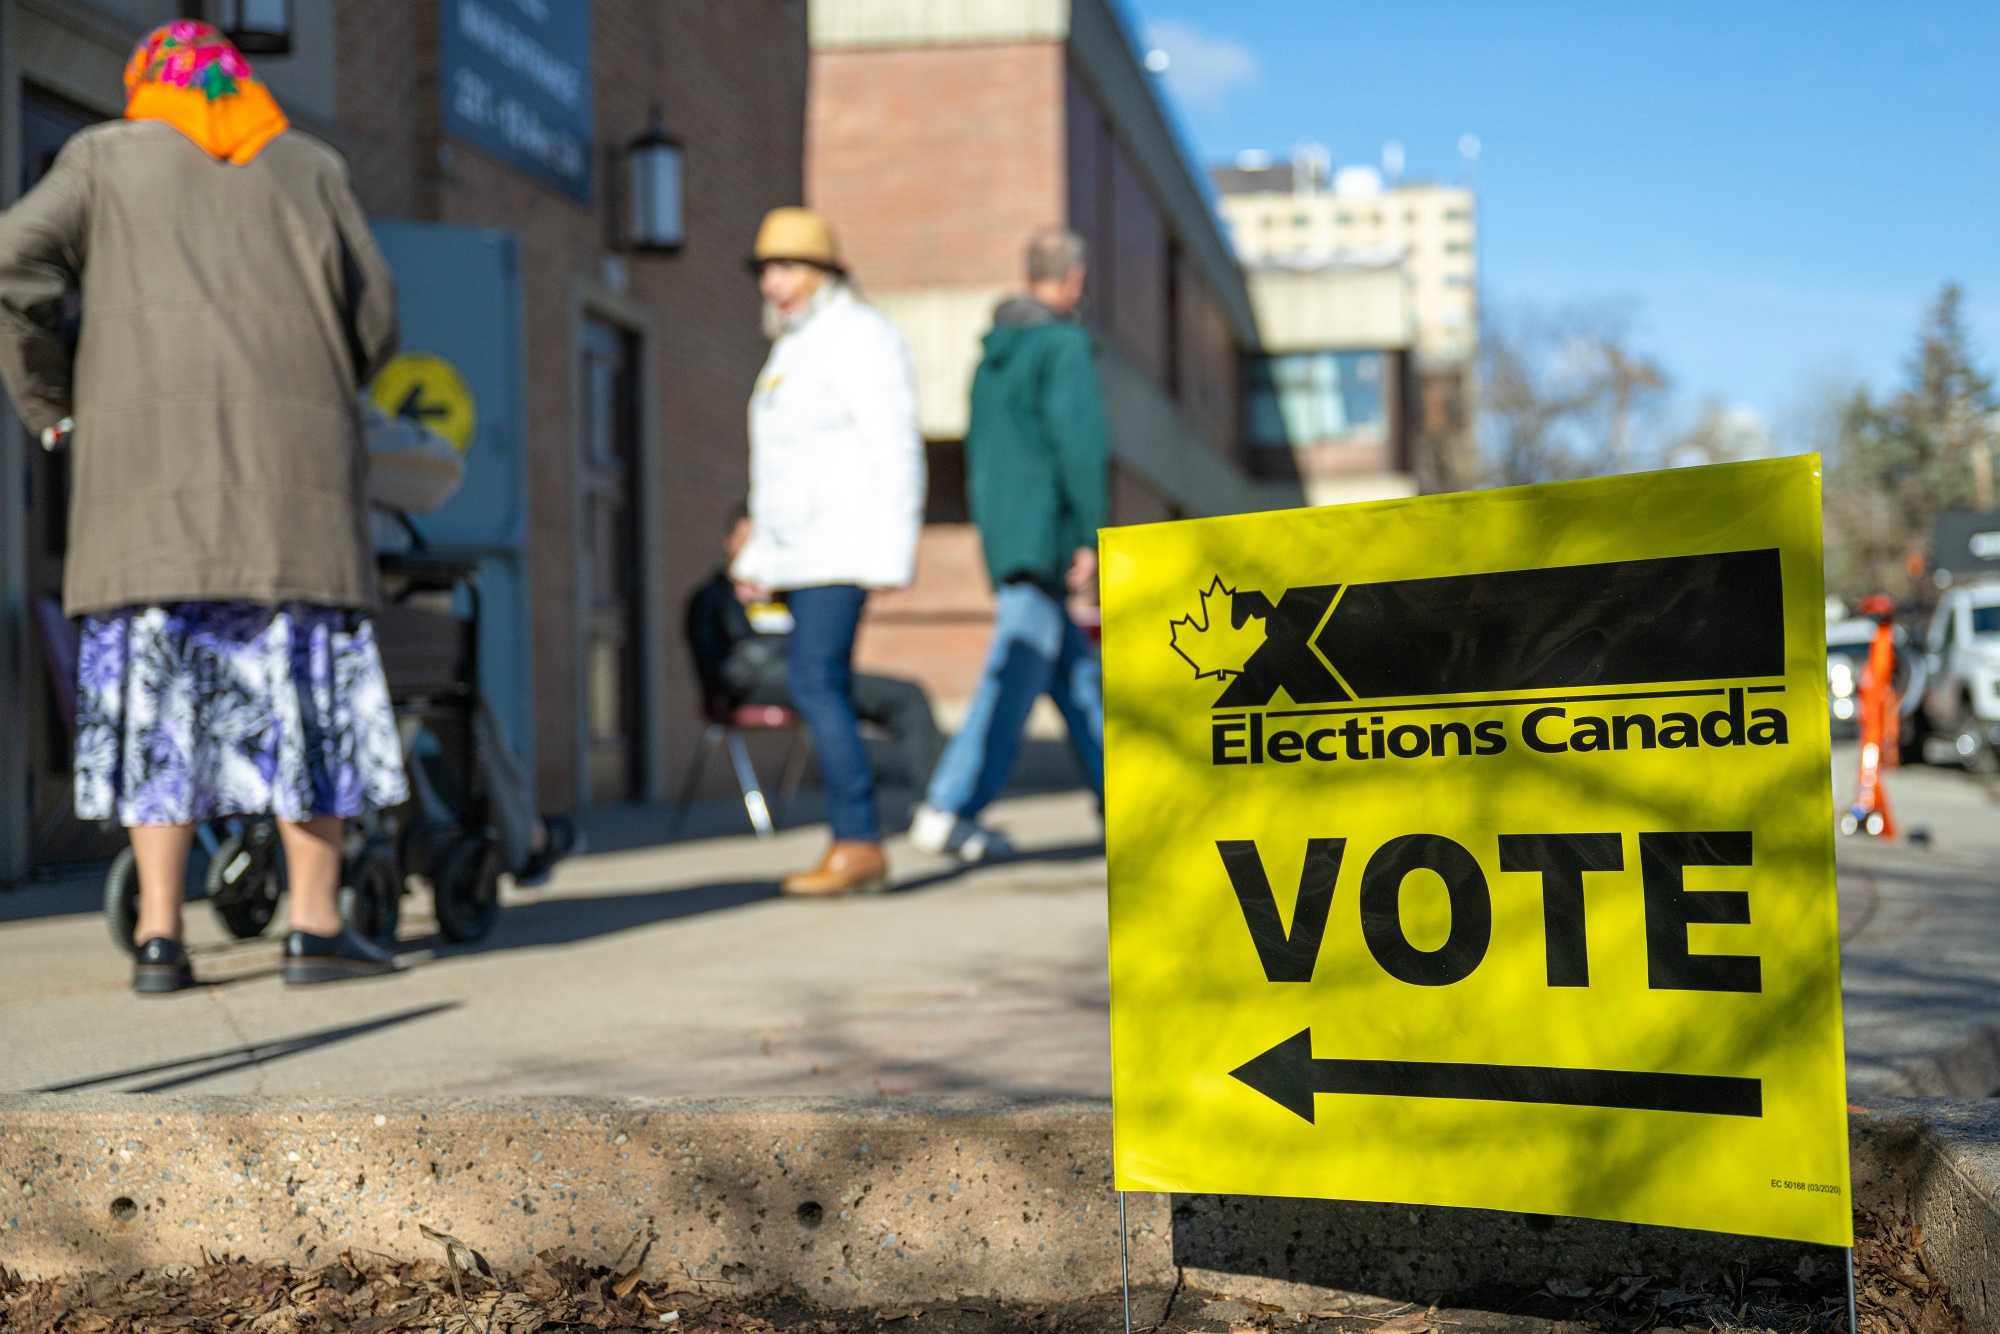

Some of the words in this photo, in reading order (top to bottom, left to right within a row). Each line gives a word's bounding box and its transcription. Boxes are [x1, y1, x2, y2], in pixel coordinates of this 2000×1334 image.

[1211, 711, 1507, 766] Elections
[1520, 687, 1789, 754] Canada
[1215, 830, 1763, 994] VOTE
[1771, 1179, 1782, 1188] EC
[1784, 1180, 1806, 1191] 50168
[1807, 1183, 1842, 1196] (03/2020)
